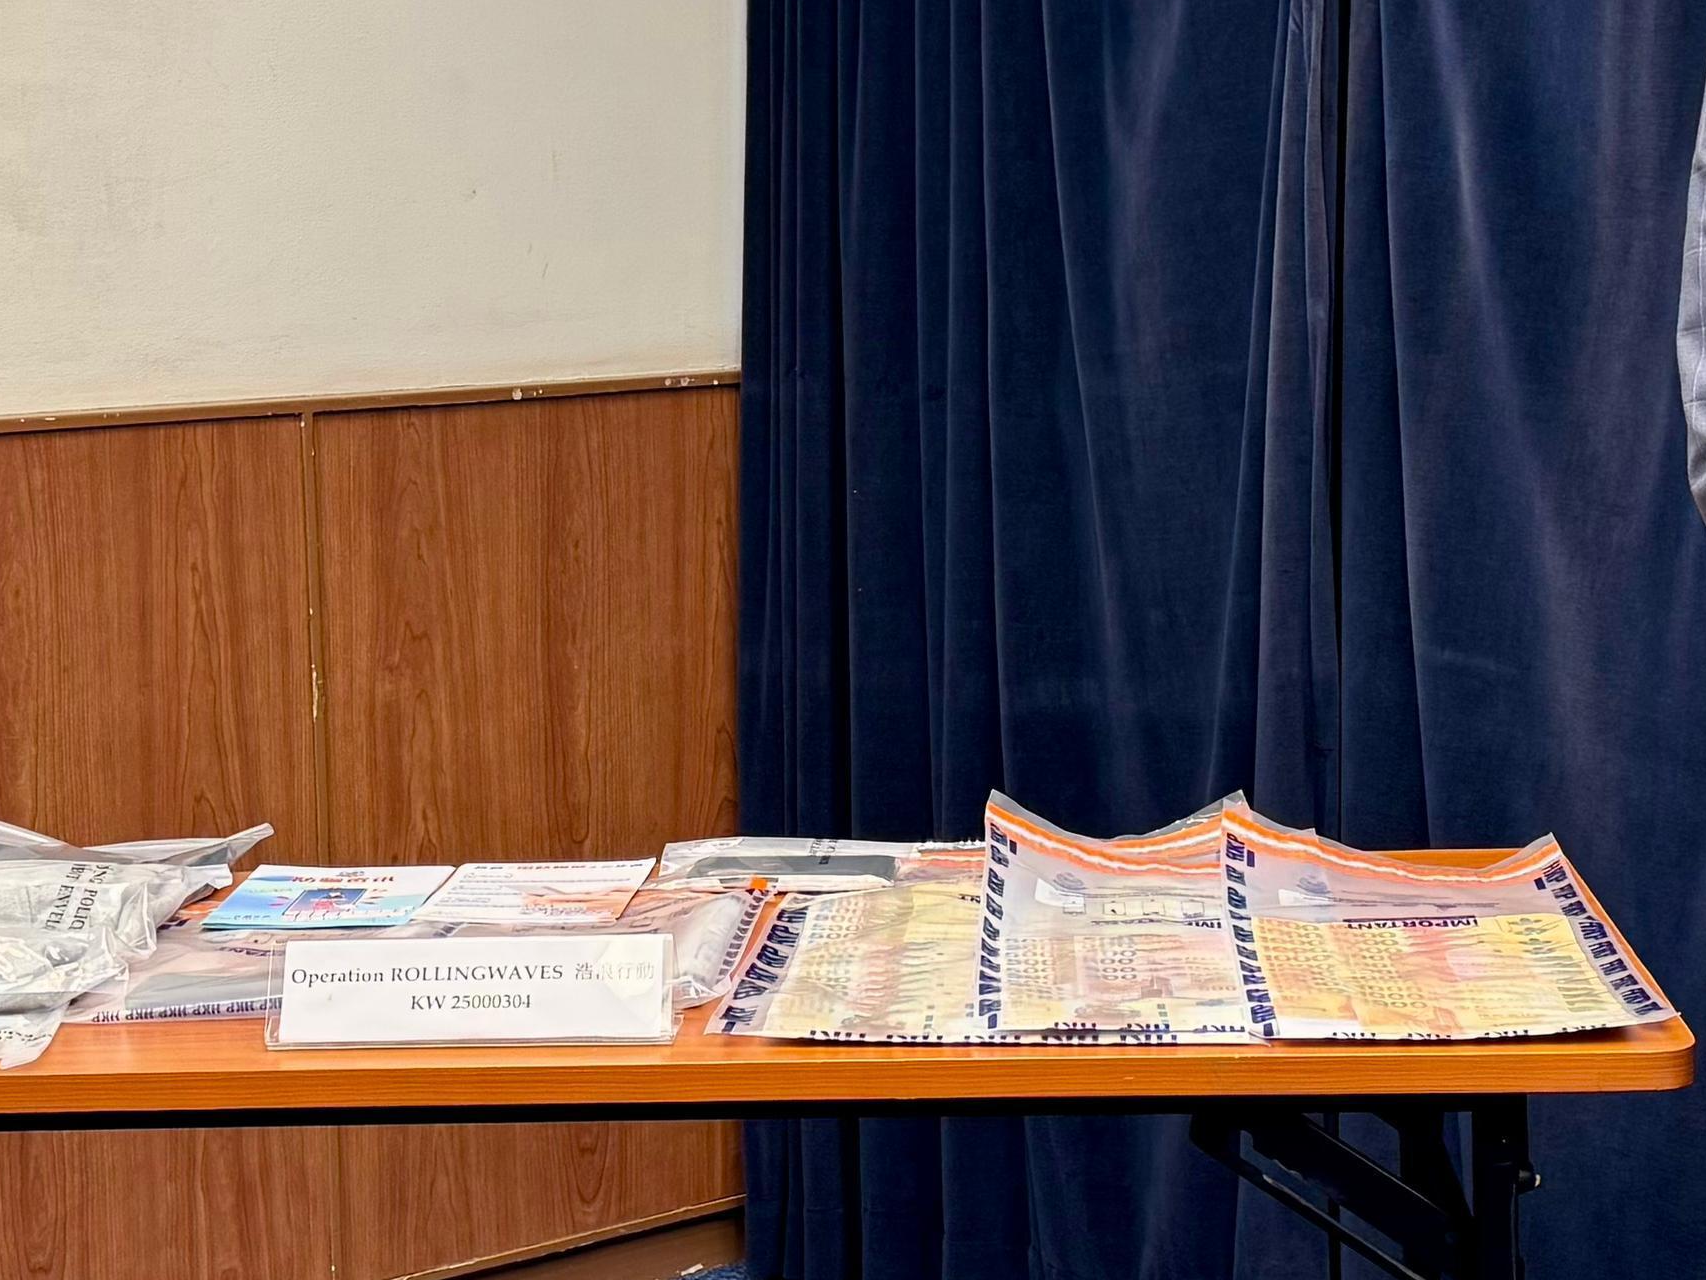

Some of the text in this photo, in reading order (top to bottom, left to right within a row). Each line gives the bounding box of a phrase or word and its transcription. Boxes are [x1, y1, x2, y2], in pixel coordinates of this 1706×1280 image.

[68, 889, 98, 930] POLIC
[1348, 918, 1479, 930] IMPORTANT
[291, 968, 384, 987] Operation
[391, 965, 563, 982] ROLLINGWAVES
[226, 1001, 255, 1014] HKP
[411, 993, 532, 1010] KW 25000304
[91, 1010, 120, 1023] HKP
[125, 1008, 154, 1021] HKP
[158, 1006, 187, 1019] HKP
[192, 1004, 220, 1017] HKP
